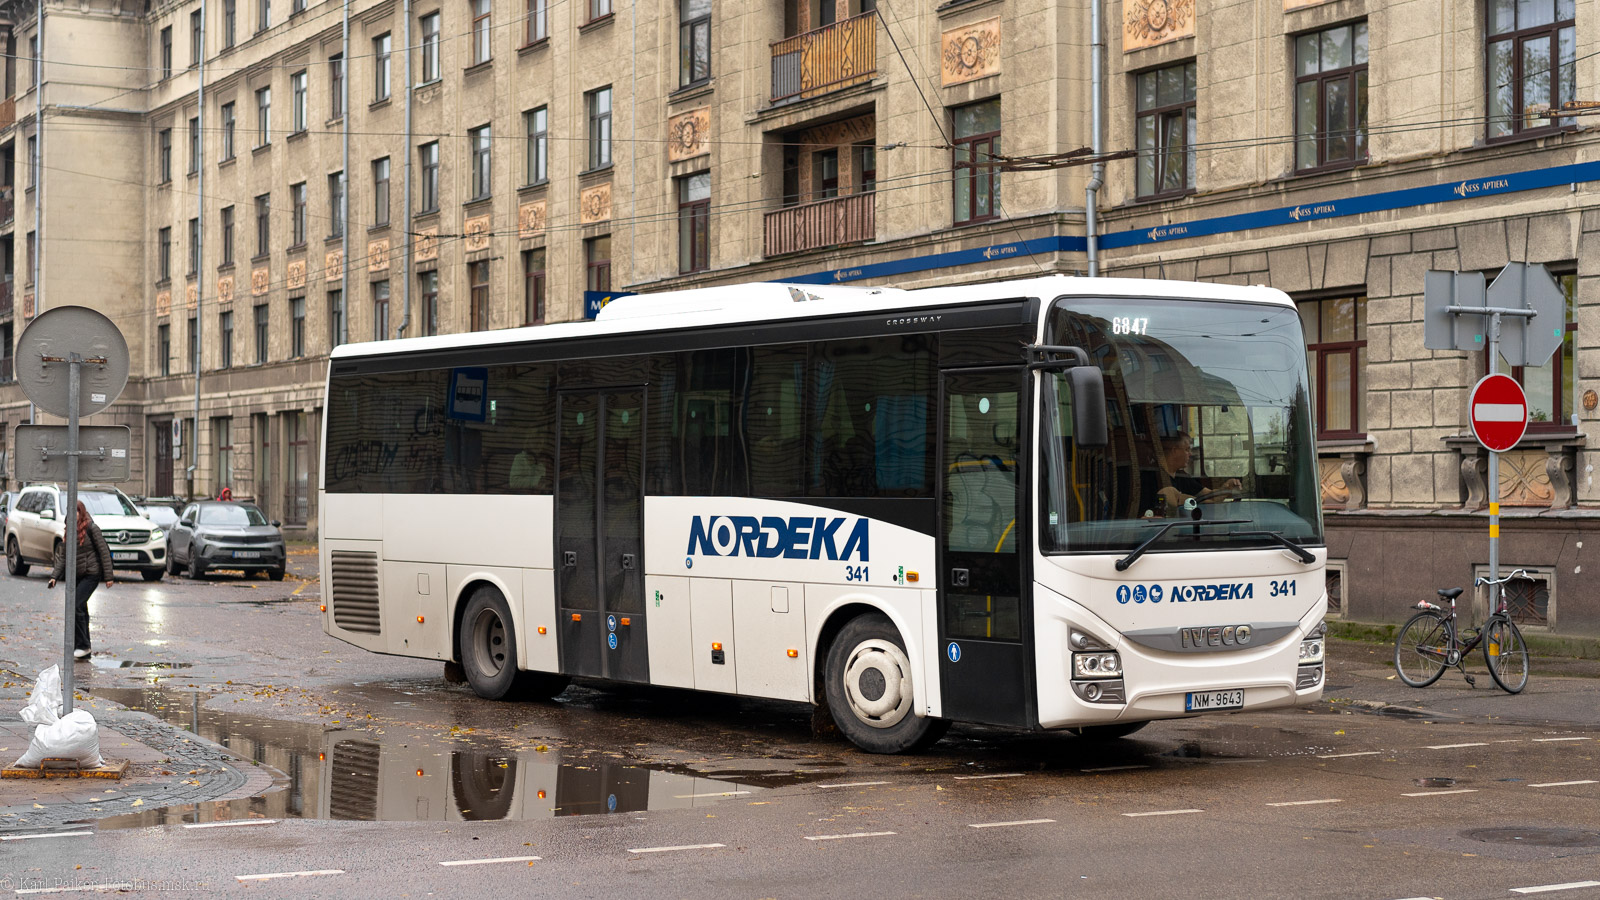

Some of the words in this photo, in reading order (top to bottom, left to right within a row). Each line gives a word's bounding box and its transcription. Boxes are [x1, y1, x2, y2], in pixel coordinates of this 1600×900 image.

[1482, 179, 1509, 190] APTIEKA
[1313, 204, 1336, 215] APTIEKA
[886, 315, 942, 326] CROSSWAY
[1112, 317, 1148, 336] 6847
[687, 515, 870, 562] NORDEKA
[845, 565, 870, 582] 341
[1170, 583, 1254, 602] NORDEKA
[1269, 580, 1297, 597] 341
[1181, 625, 1252, 648] IVECO
[1194, 691, 1242, 708] NM-9643
